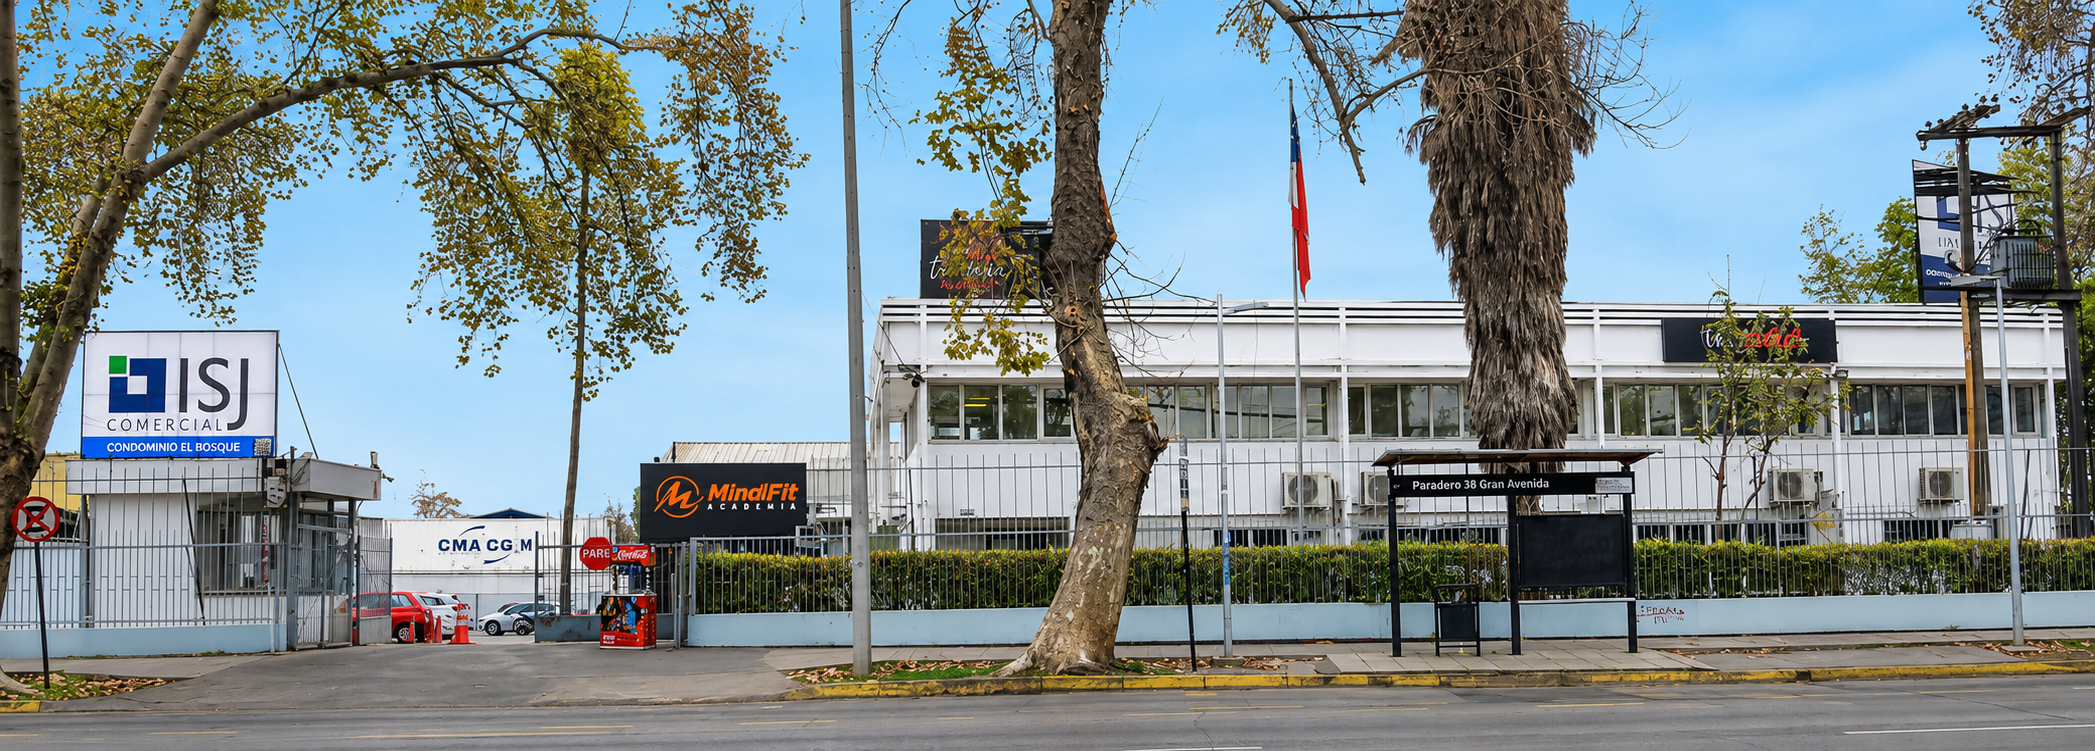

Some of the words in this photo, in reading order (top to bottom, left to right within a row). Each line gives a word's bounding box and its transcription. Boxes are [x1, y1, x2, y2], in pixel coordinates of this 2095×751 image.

[179, 357, 249, 431] ISJ
[107, 418, 222, 431] COMERCIAL
[107, 442, 178, 453] CONDOMINIO
[181, 442, 193, 452] EL
[195, 442, 241, 454] BOSQUE
[1412, 480, 1462, 491] Paradero
[1463, 480, 1477, 490] 38
[1479, 480, 1505, 490] Gran
[1507, 478, 1550, 489] Avenida
[707, 503, 796, 511] ACADEMIA
[438, 539, 482, 552] CMA
[582, 548, 611, 559] PARE
